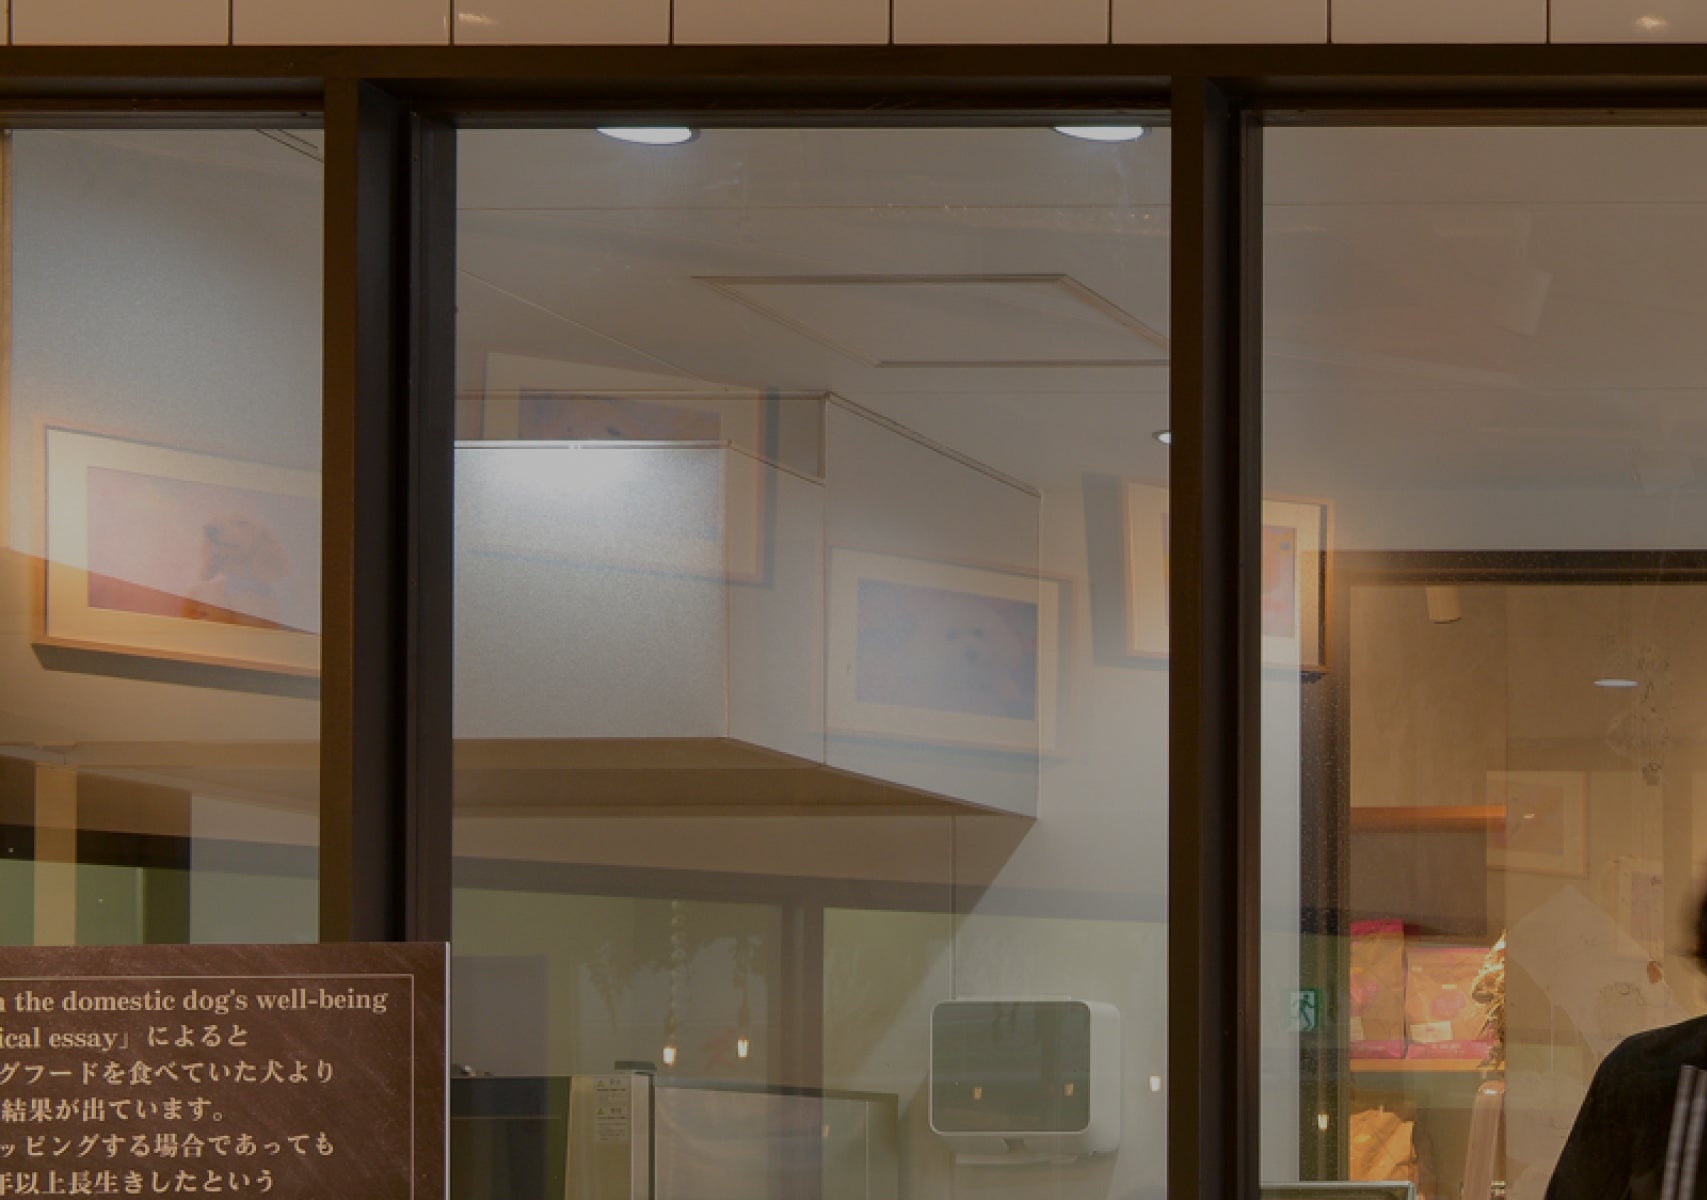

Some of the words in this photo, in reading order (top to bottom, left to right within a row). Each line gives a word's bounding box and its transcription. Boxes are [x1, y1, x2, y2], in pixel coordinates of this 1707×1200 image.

[15, 989, 54, 1012] the
[62, 989, 175, 1012] domestic
[183, 988, 248, 1015] dog's
[257, 987, 388, 1014] well-being
[148, 1024, 248, 1048] によると
[0, 1061, 334, 1086] グフードを食べていた犬より
[2, 1098, 223, 1123] 結果が出ています。
